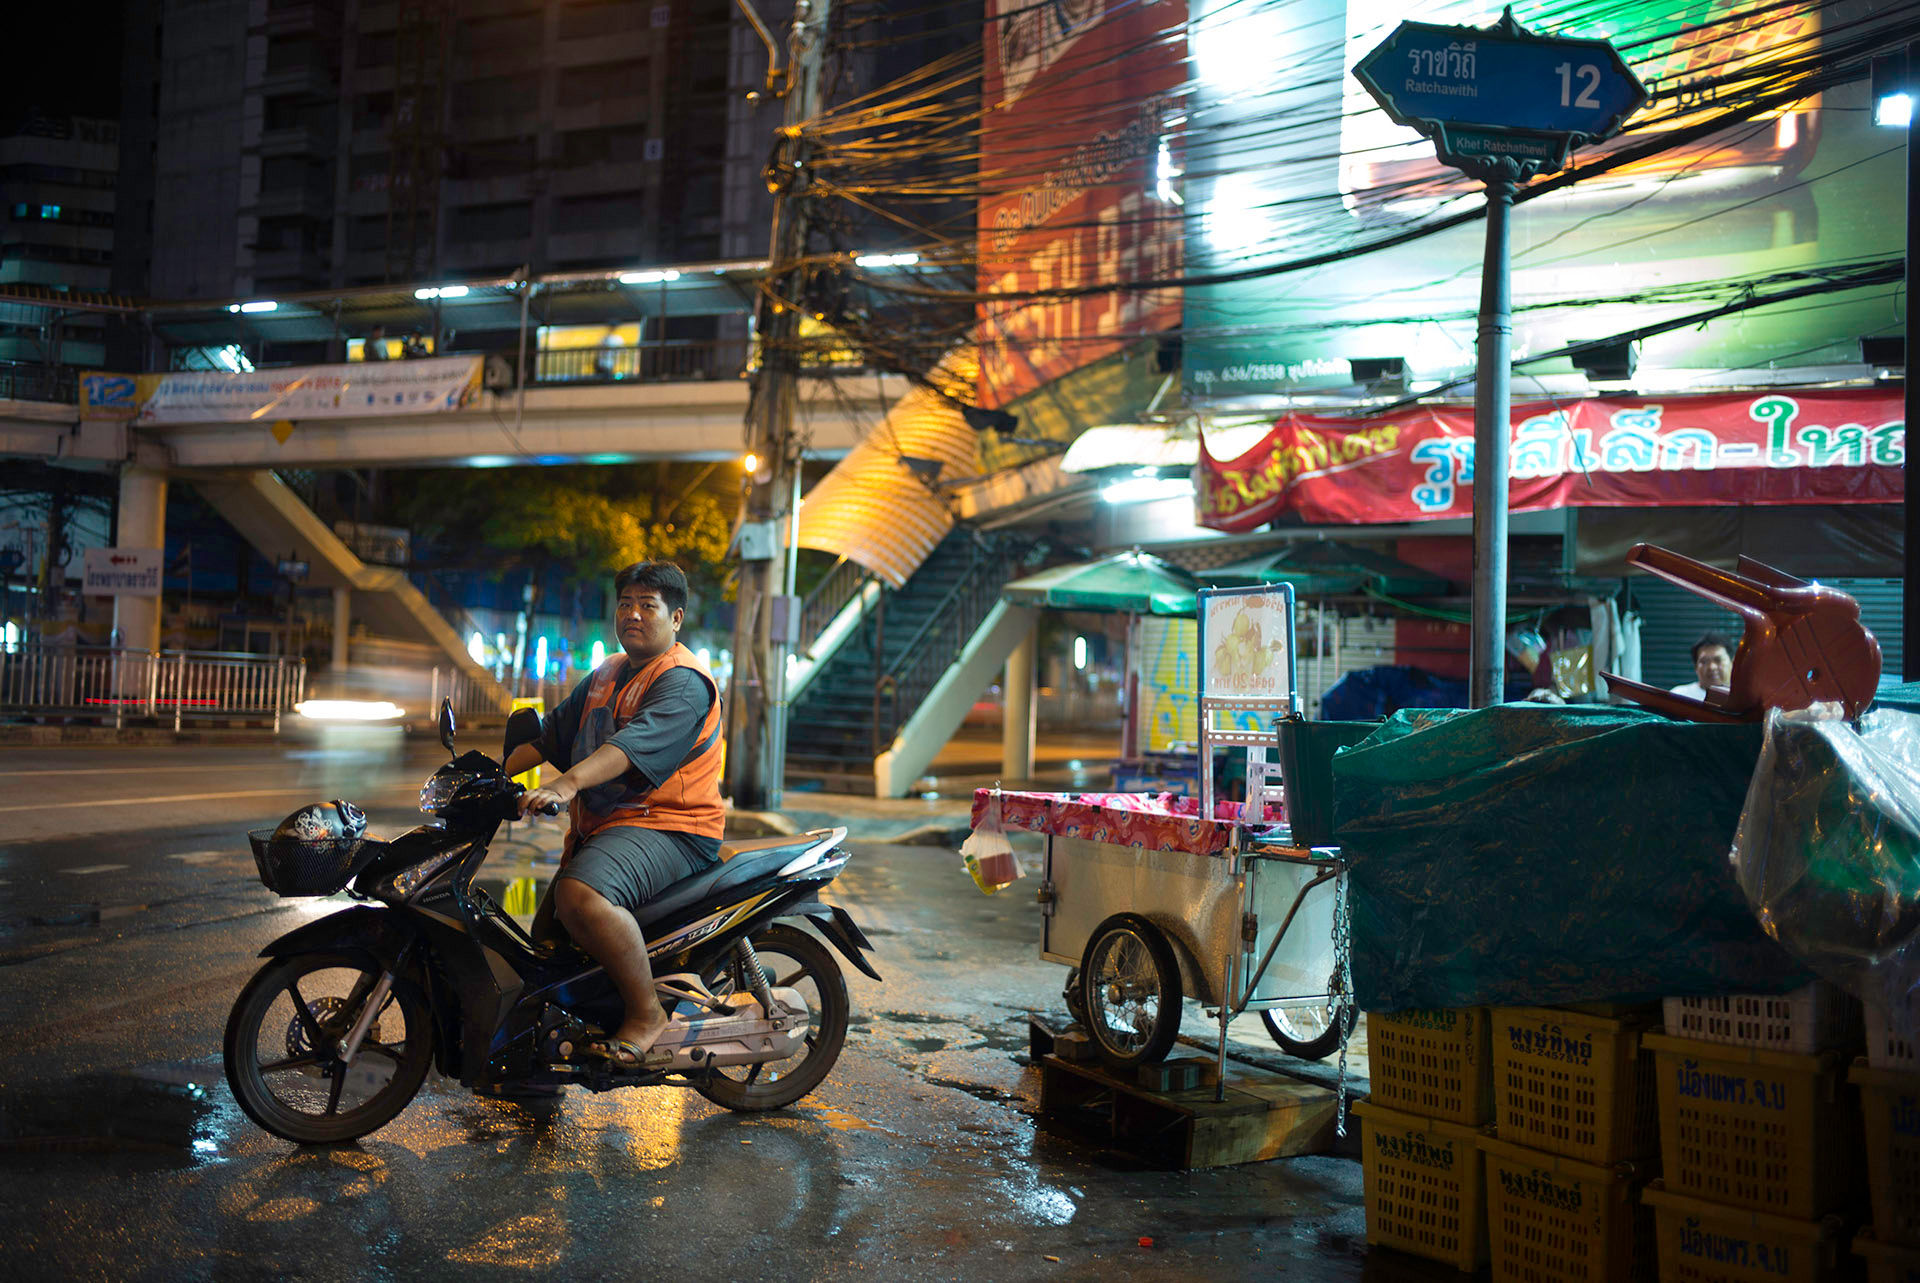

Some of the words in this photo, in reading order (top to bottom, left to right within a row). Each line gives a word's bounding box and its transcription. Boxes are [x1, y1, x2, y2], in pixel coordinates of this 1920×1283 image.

[1407, 41, 1477, 80] ราชวิถี
[1405, 79, 1478, 98] Ratchawithi
[1554, 62, 1601, 109] 12
[1456, 136, 1482, 150] Khet
[1222, 362, 1285, 382] 636/2558
